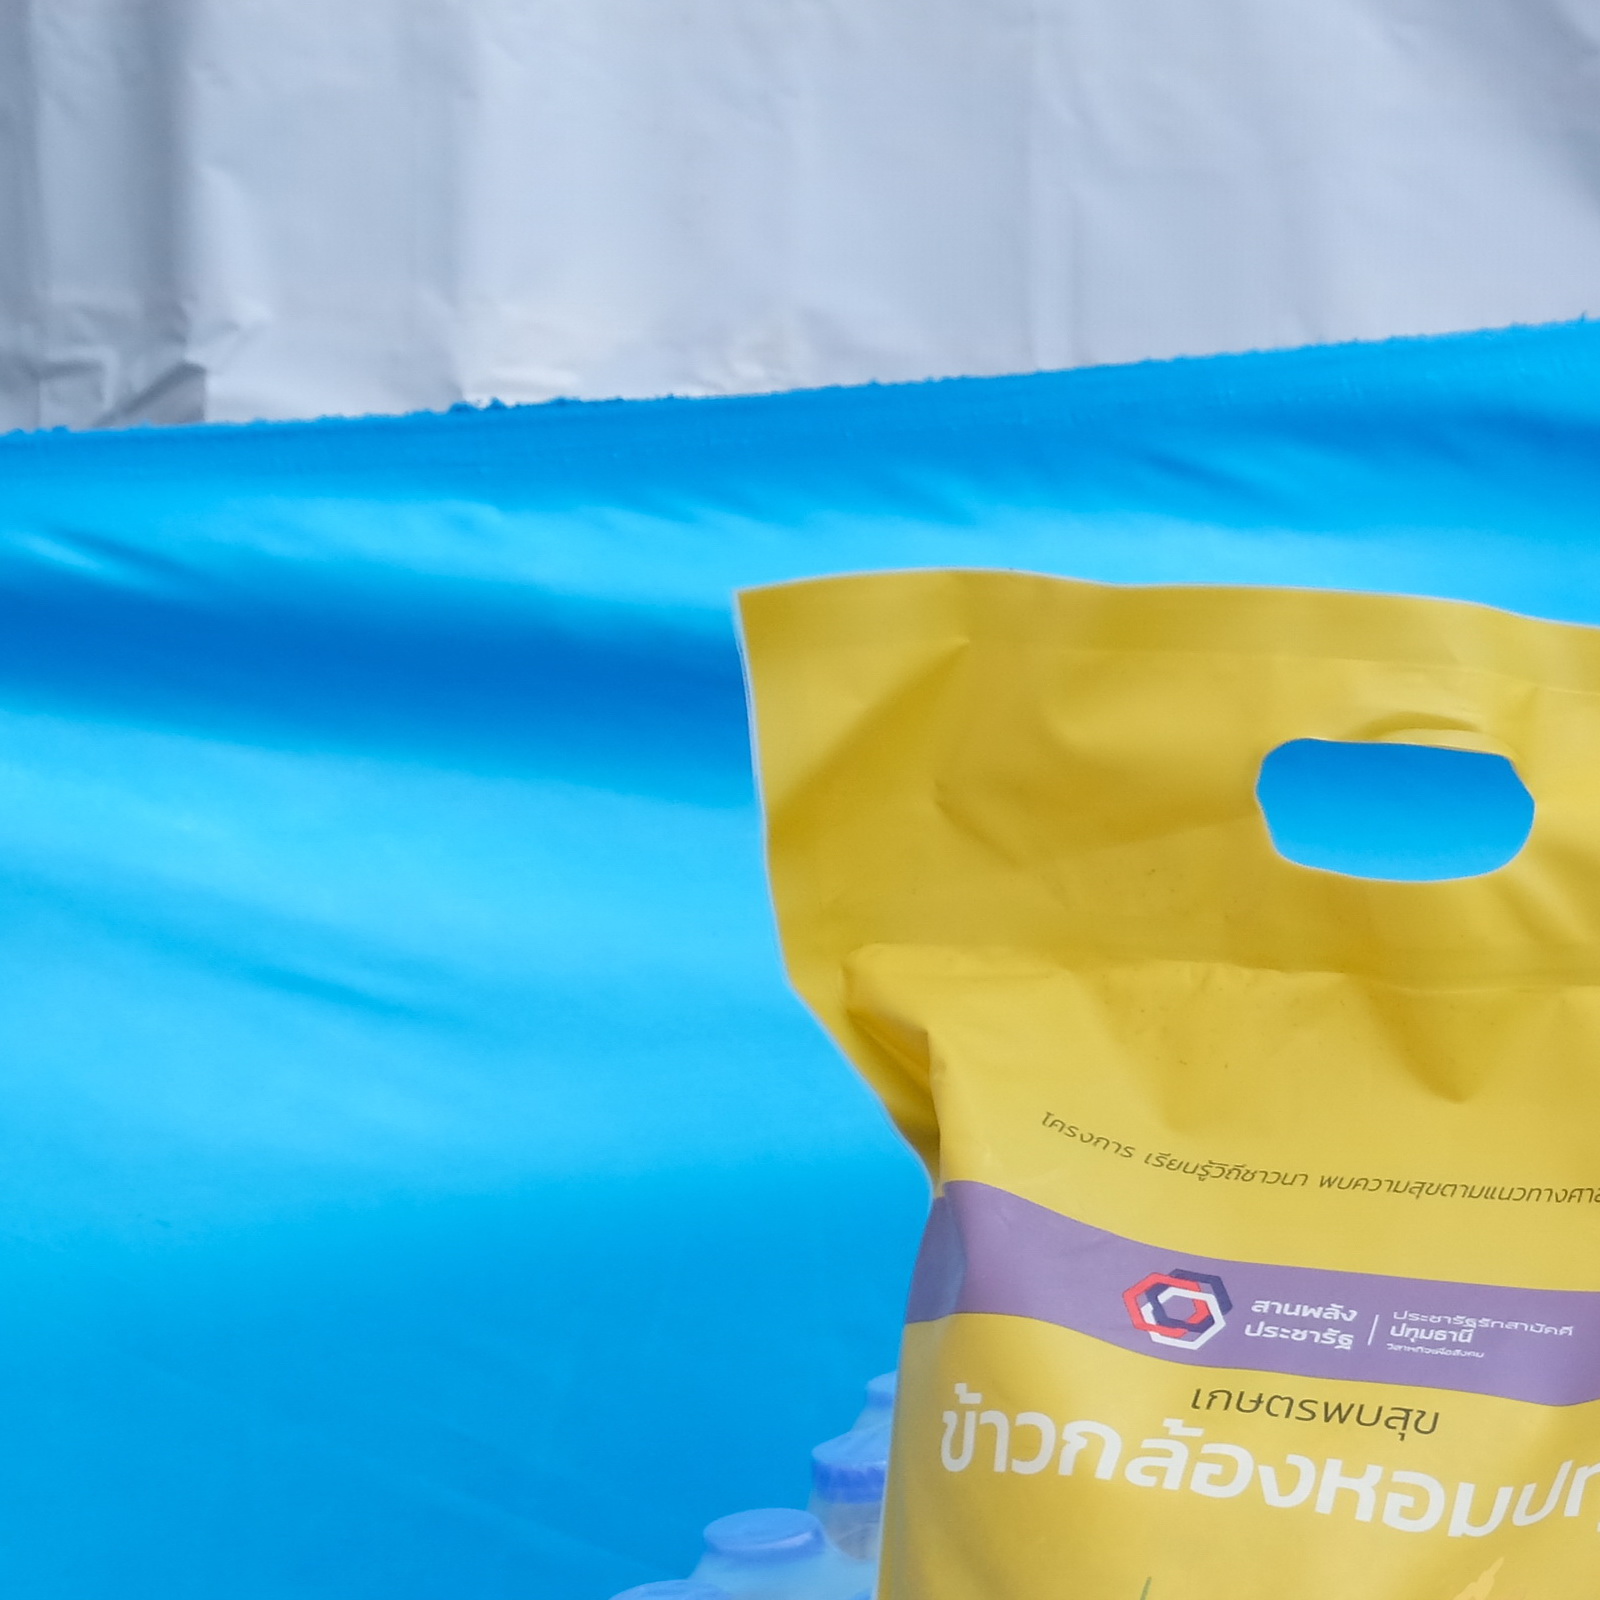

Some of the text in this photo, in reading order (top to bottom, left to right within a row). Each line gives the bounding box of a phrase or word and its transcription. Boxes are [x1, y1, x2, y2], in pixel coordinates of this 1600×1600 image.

[1041, 1111, 1136, 1160] โครงการ
[1144, 1151, 1309, 1188] เรียนรู้วิถีชาวนา
[1250, 1298, 1358, 1323] สานพลัง
[1392, 1309, 1575, 1338] ประชารัฐรักสามัคคี
[1244, 1320, 1356, 1350] ประชารัฐ
[1389, 1323, 1476, 1345] ปทุมธานี
[1190, 1382, 1441, 1442] เกษตรพบสุข
